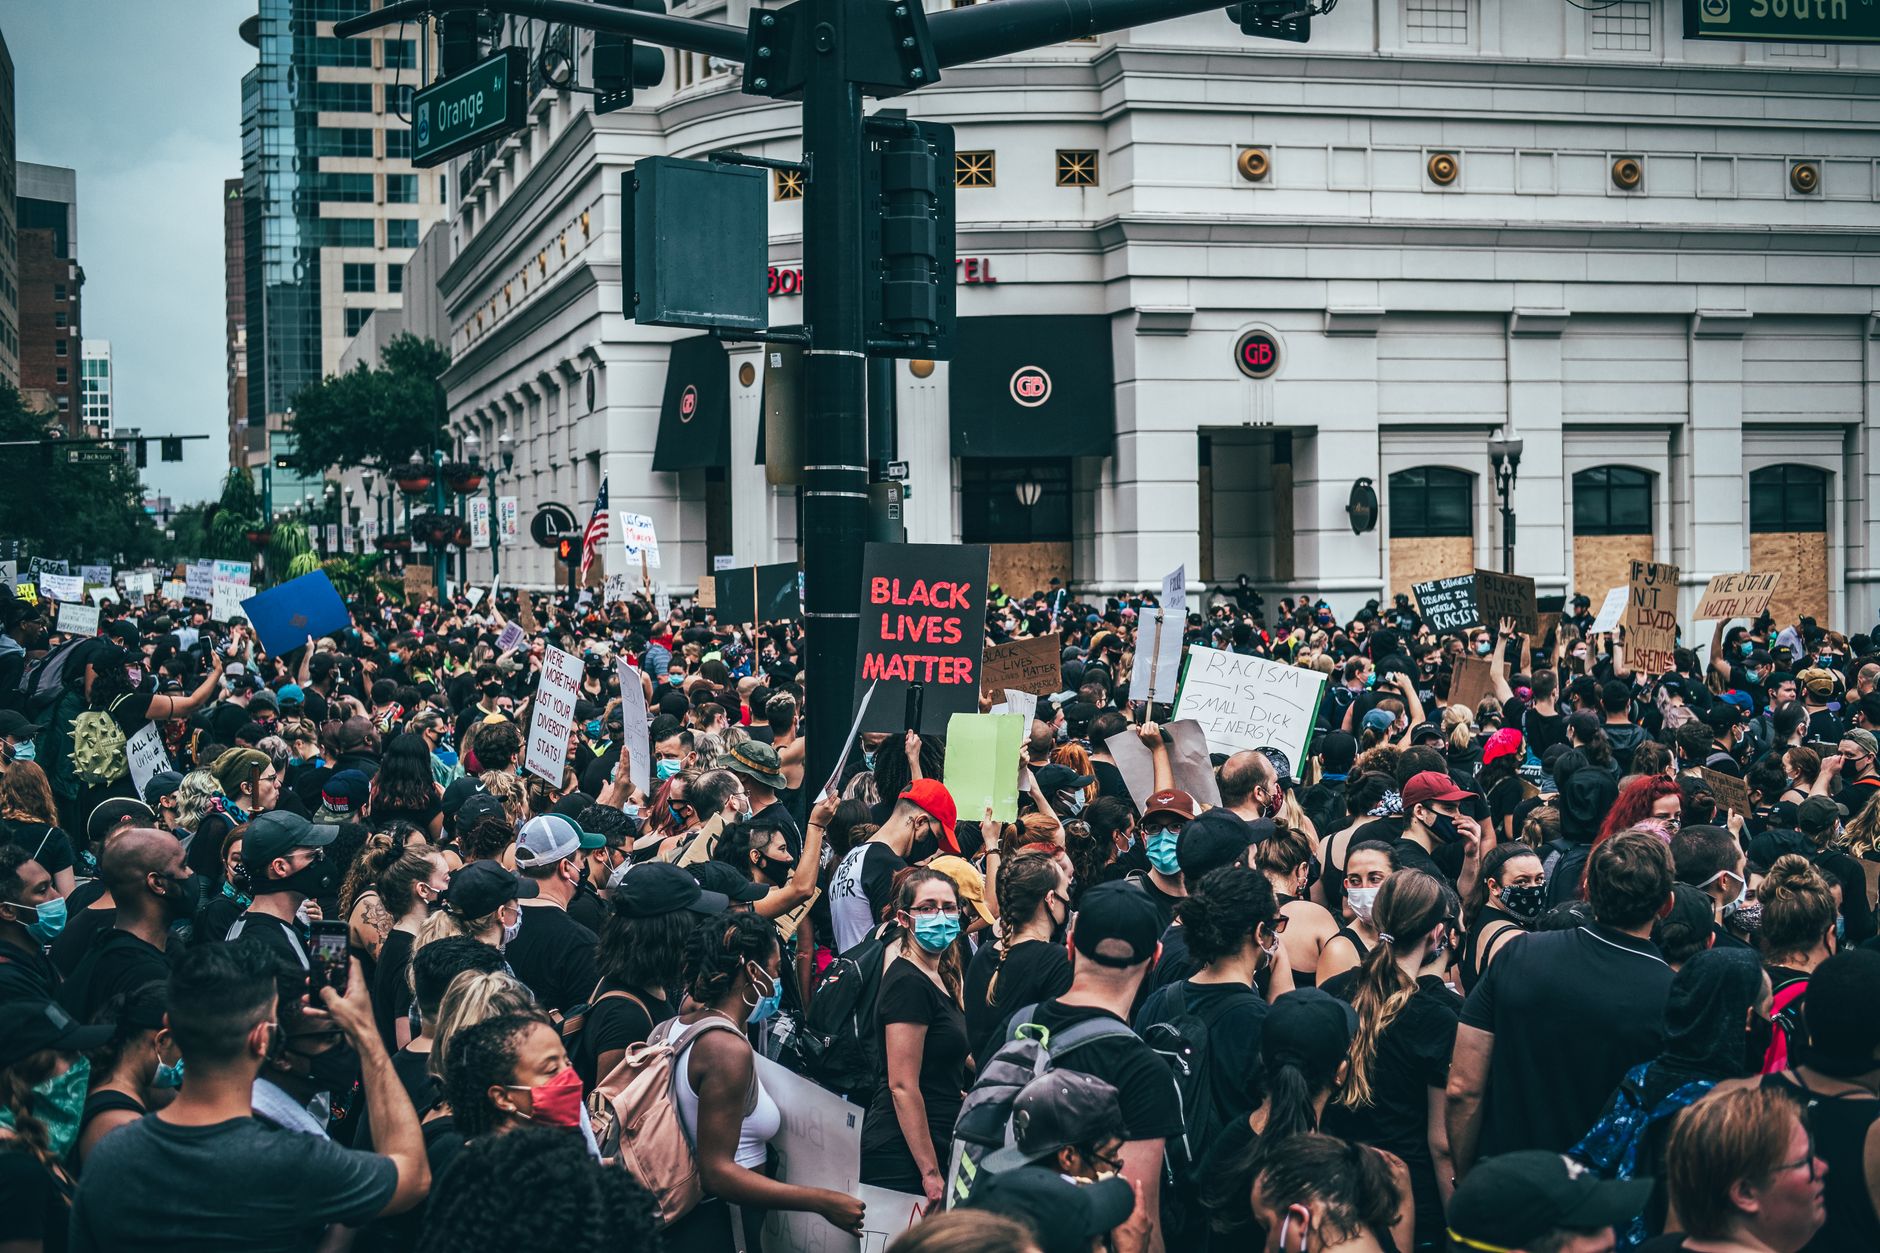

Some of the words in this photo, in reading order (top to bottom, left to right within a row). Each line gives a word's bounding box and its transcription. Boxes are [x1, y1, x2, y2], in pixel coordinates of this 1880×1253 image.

[1749, 0, 1848, 20] South
[438, 91, 484, 131] Orange
[493, 76, 503, 92] Av
[1244, 343, 1273, 365] GB
[1016, 376, 1046, 397] GB
[81, 453, 113, 461] Jackson
[472, 502, 480, 537] ORLANDO
[1631, 561, 1643, 582] IF
[870, 576, 972, 610] BLACK
[1412, 581, 1437, 595] THE
[1454, 589, 1469, 600] IN
[1483, 575, 1528, 600] BLACK
[1714, 575, 1738, 595] WE
[1484, 592, 1523, 614] LIVES
[1633, 586, 1662, 610] NOT
[1702, 597, 1740, 618] WITH
[1740, 595, 1769, 616] YOU
[880, 612, 963, 645] LIVES
[1637, 608, 1676, 632] LIVID
[983, 646, 1018, 664] BLACK
[1003, 656, 1033, 671] LIVES
[862, 652, 974, 685] MATTER
[1023, 664, 1057, 678] MATTER
[1206, 652, 1300, 688] RACISM
[544, 667, 564, 688] MORE
[562, 674, 581, 696] THAN
[1235, 685, 1255, 701] IS
[536, 688, 553, 707] JUST
[553, 697, 571, 719] YOUR
[1183, 693, 1239, 714] SMALL
[1250, 705, 1292, 728] DICK
[536, 712, 570, 742] DIVERSITY
[1210, 717, 1277, 745] ENERGY
[132, 740, 147, 755] ALL
[536, 738, 562, 764] STATS!
